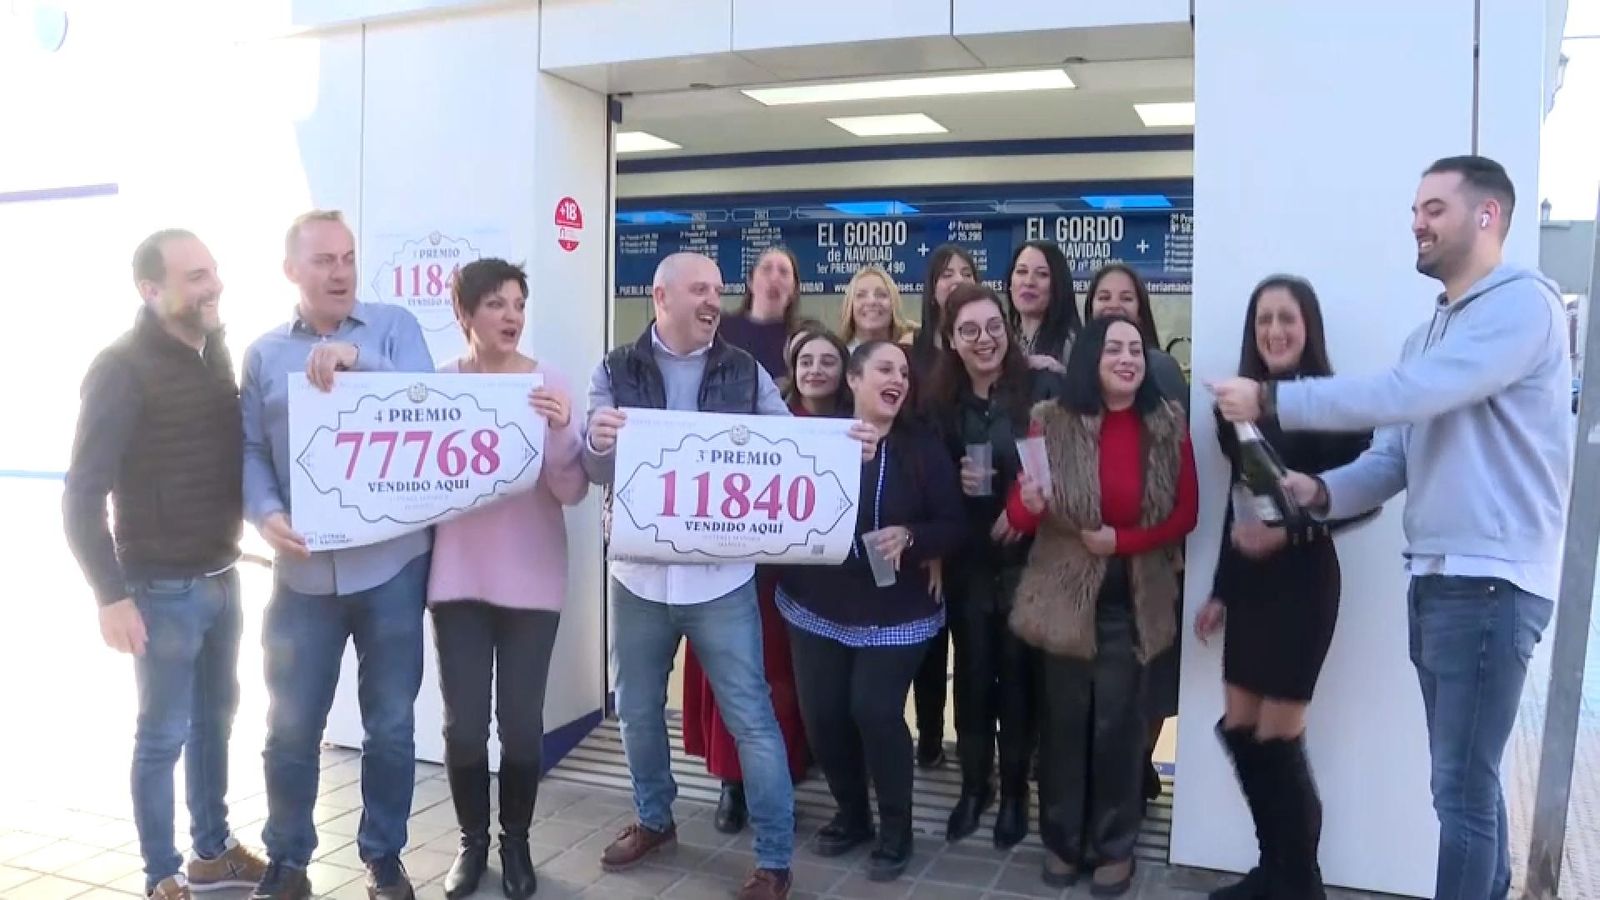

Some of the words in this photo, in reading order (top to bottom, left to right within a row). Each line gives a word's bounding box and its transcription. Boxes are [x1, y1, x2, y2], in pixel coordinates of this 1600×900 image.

[560, 202, 577, 221] +18
[817, 223, 839, 247] EL
[845, 221, 907, 246] GORDO
[1026, 217, 1049, 240] EL
[1056, 215, 1124, 242] GORDO
[420, 248, 460, 258] PREMIO
[828, 248, 841, 262] de
[844, 246, 893, 262] NAVIDAD
[1058, 242, 1110, 258] NAVIDAD
[393, 263, 460, 297] 1184
[389, 407, 462, 422] PREMIO
[335, 429, 501, 480] 77768
[711, 449, 782, 466] PREMIO
[367, 481, 431, 493] VENDIDO
[434, 478, 470, 492] AQUÍ
[657, 469, 816, 522] 11840
[684, 521, 746, 532] VENDIDO
[749, 522, 783, 534] AQUÍ
